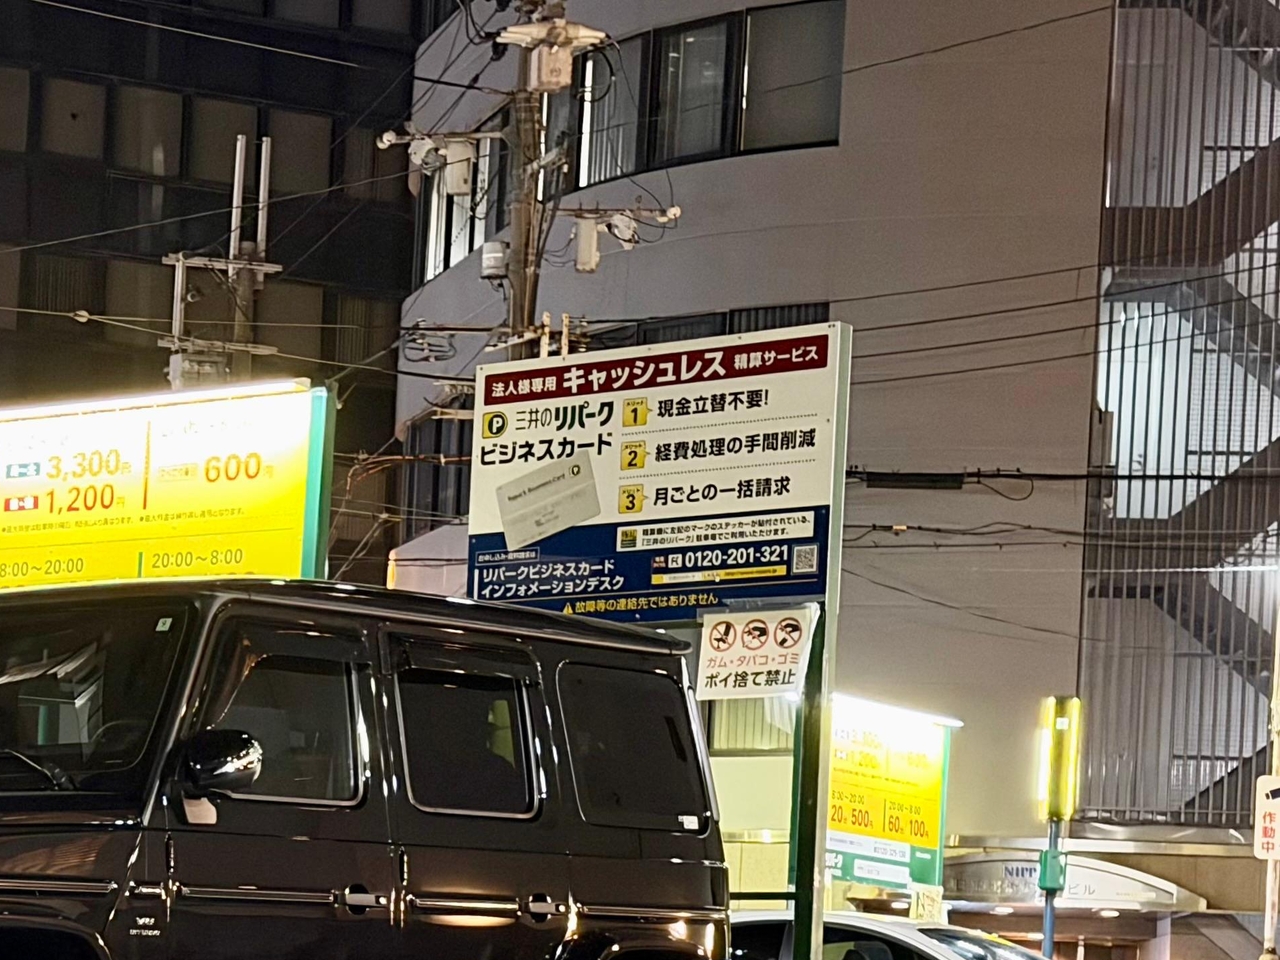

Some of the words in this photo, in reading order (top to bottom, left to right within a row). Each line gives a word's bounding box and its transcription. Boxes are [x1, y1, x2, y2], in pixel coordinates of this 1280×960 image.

[491, 377, 557, 398] 法人様専用
[563, 351, 726, 394] キャッシュレス
[733, 345, 819, 370] 精算サービス
[630, 407, 638, 424] 1
[657, 388, 769, 418] 現金立替不要!
[515, 401, 614, 433] 三井のリパーク
[480, 432, 613, 466] ビジネスカード
[655, 428, 817, 462] 経費処理の手間削減
[627, 450, 638, 467] 2
[625, 494, 636, 511] 3
[653, 476, 791, 506] 月ごとの一括請求
[685, 545, 788, 568] 0120-201-321
[483, 559, 615, 583] リパークビジネスカード
[481, 574, 624, 599] インフォメーションデスク
[575, 593, 719, 613] 故障等の連絡先ではありません
[705, 668, 796, 689] ポイ捨て禁止
[1261, 811, 1276, 854] 作動中
